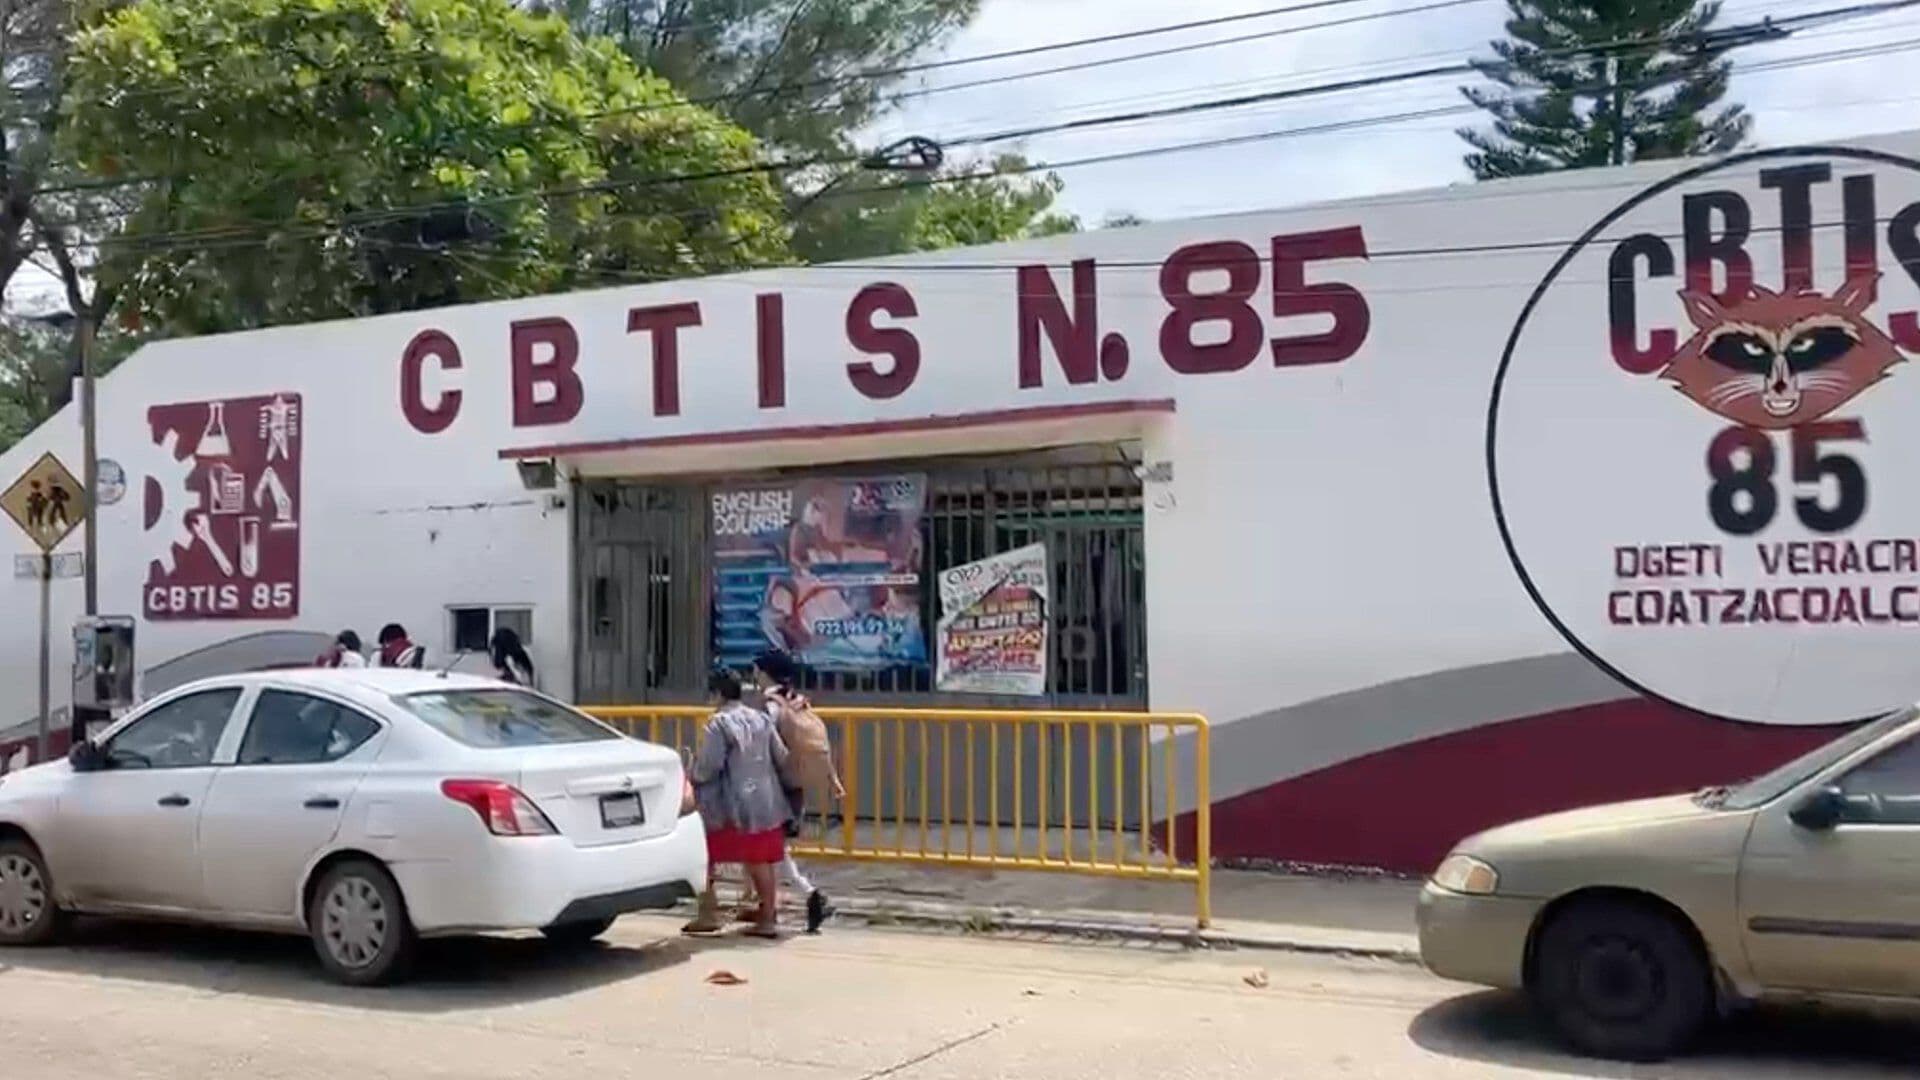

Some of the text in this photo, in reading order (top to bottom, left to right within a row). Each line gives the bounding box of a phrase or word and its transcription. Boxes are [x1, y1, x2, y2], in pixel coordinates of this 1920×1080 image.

[400, 282, 921, 434] CBTIS
[1706, 417, 1868, 536] 85
[712, 490, 793, 515] ENGLISH
[1614, 543, 1723, 578] DGETI
[148, 582, 293, 612] CBTIS 85
[1607, 585, 1920, 625] COATZACOALC
